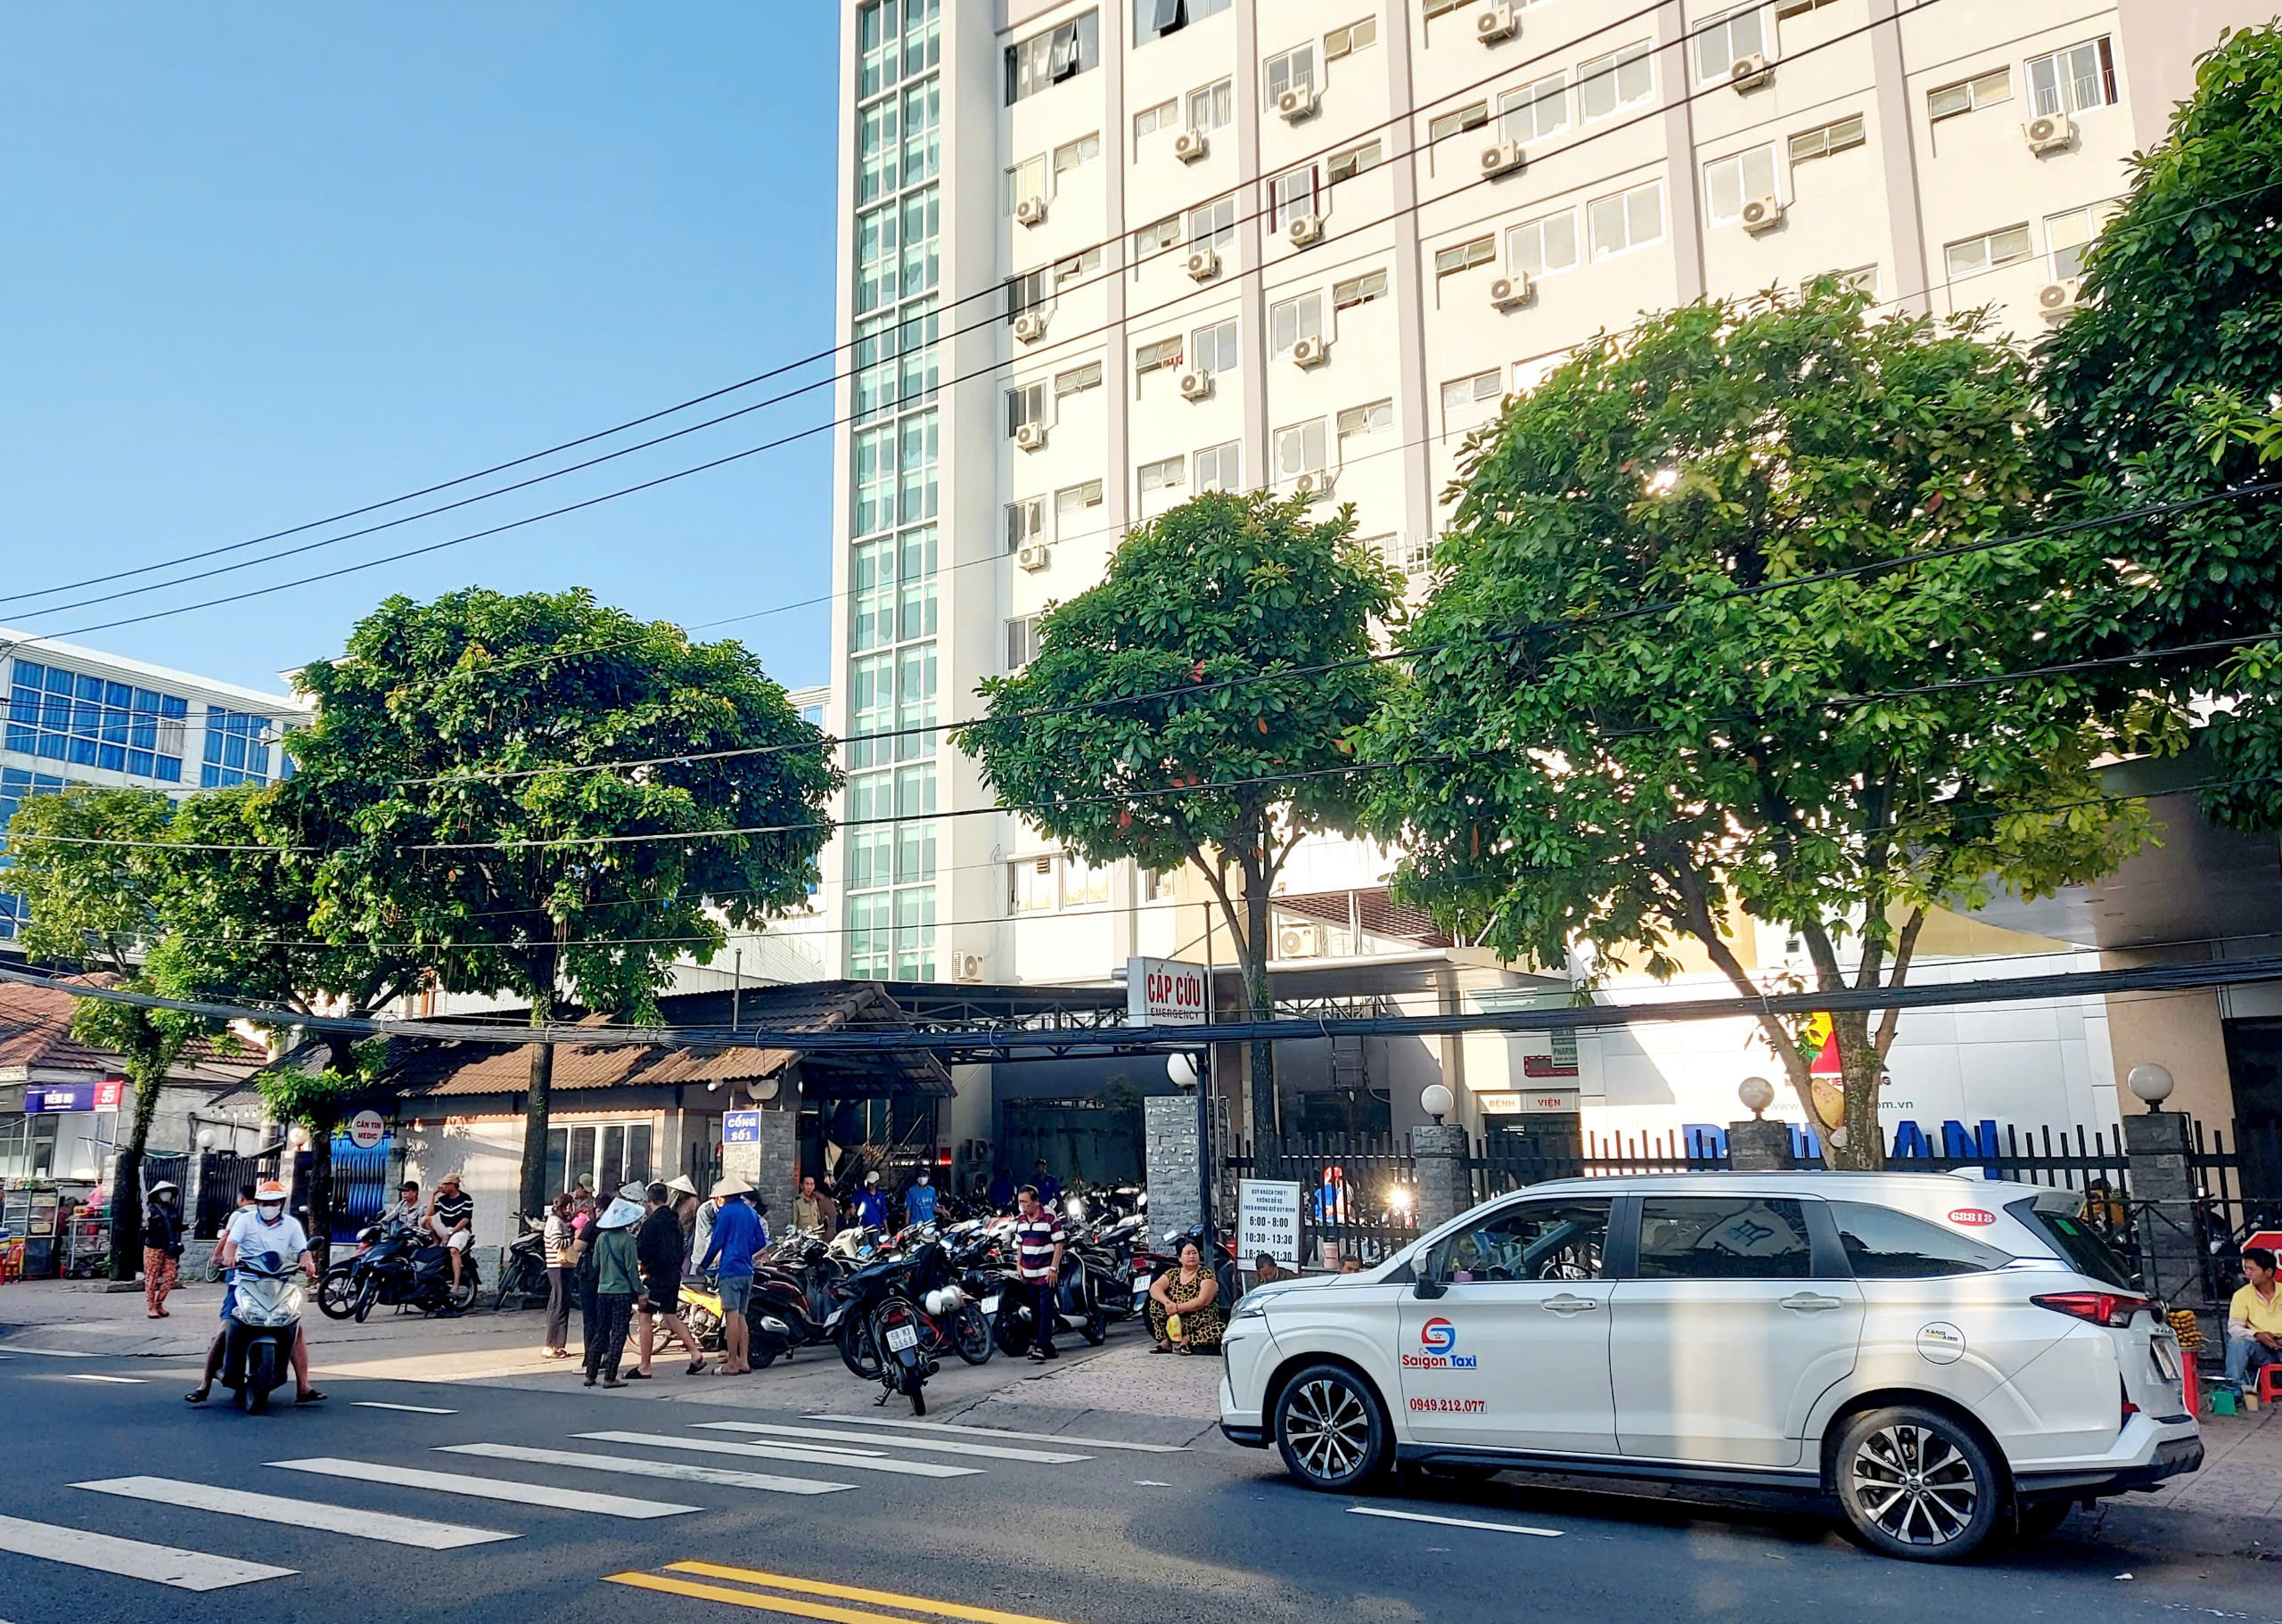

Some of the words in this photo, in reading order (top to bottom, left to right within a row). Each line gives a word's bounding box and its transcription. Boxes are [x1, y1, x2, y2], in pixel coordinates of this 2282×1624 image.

[1147, 964, 1172, 1005] CẤP
[1176, 971, 1201, 1007] CỨU
[1150, 1007, 1199, 1020] EMERGENCY
[1489, 1097, 1515, 1108] BỆNH
[1538, 1097, 1561, 1109] VIỆN
[357, 1132, 378, 1140] MEDIC
[1249, 1216, 1266, 1226] 6:00
[1272, 1217, 1289, 1228] 8:00
[1950, 1211, 1993, 1224] 68818
[1244, 1232, 1266, 1243] 10:30
[1272, 1234, 1293, 1245] 13:30
[1402, 1354, 1448, 1370] Saigon
[1450, 1355, 1477, 1367] Taxi
[1409, 1398, 1485, 1413] 0949.212.077
